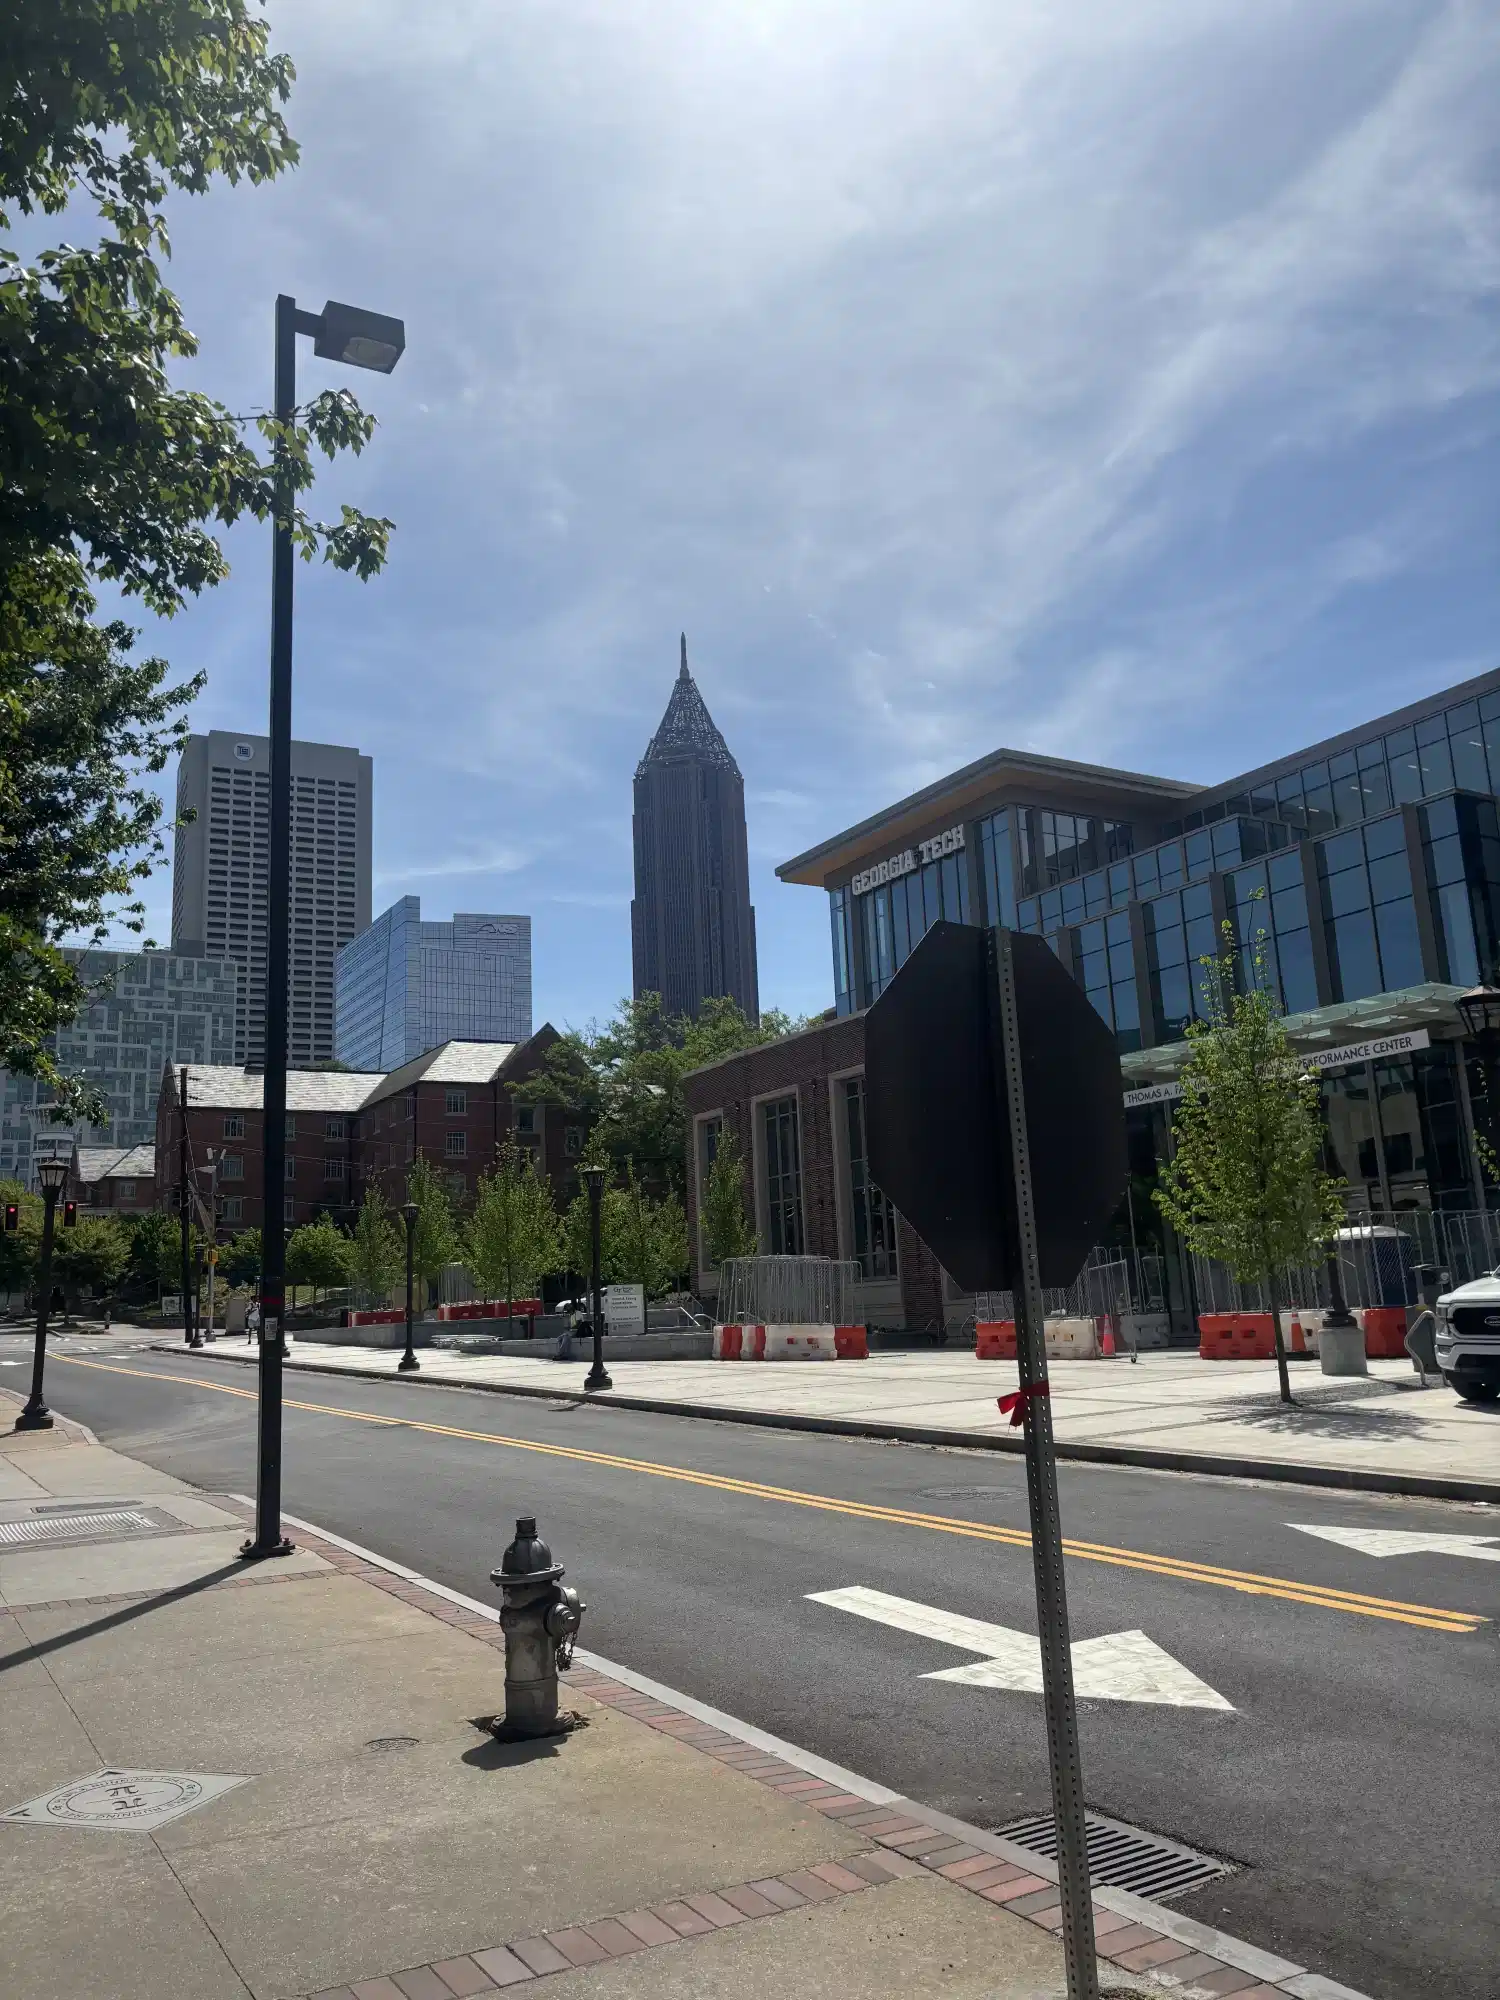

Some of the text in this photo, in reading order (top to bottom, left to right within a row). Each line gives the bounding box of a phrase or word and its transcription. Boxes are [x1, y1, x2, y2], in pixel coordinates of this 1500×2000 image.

[851, 823, 966, 896] GEORGIA TECH
[1127, 1088, 1162, 1104] THOMAS
[1163, 1087, 1173, 1097] A.
[1297, 1046, 1371, 1069] PERFORMANCE
[1373, 1036, 1413, 1053] CENTER
